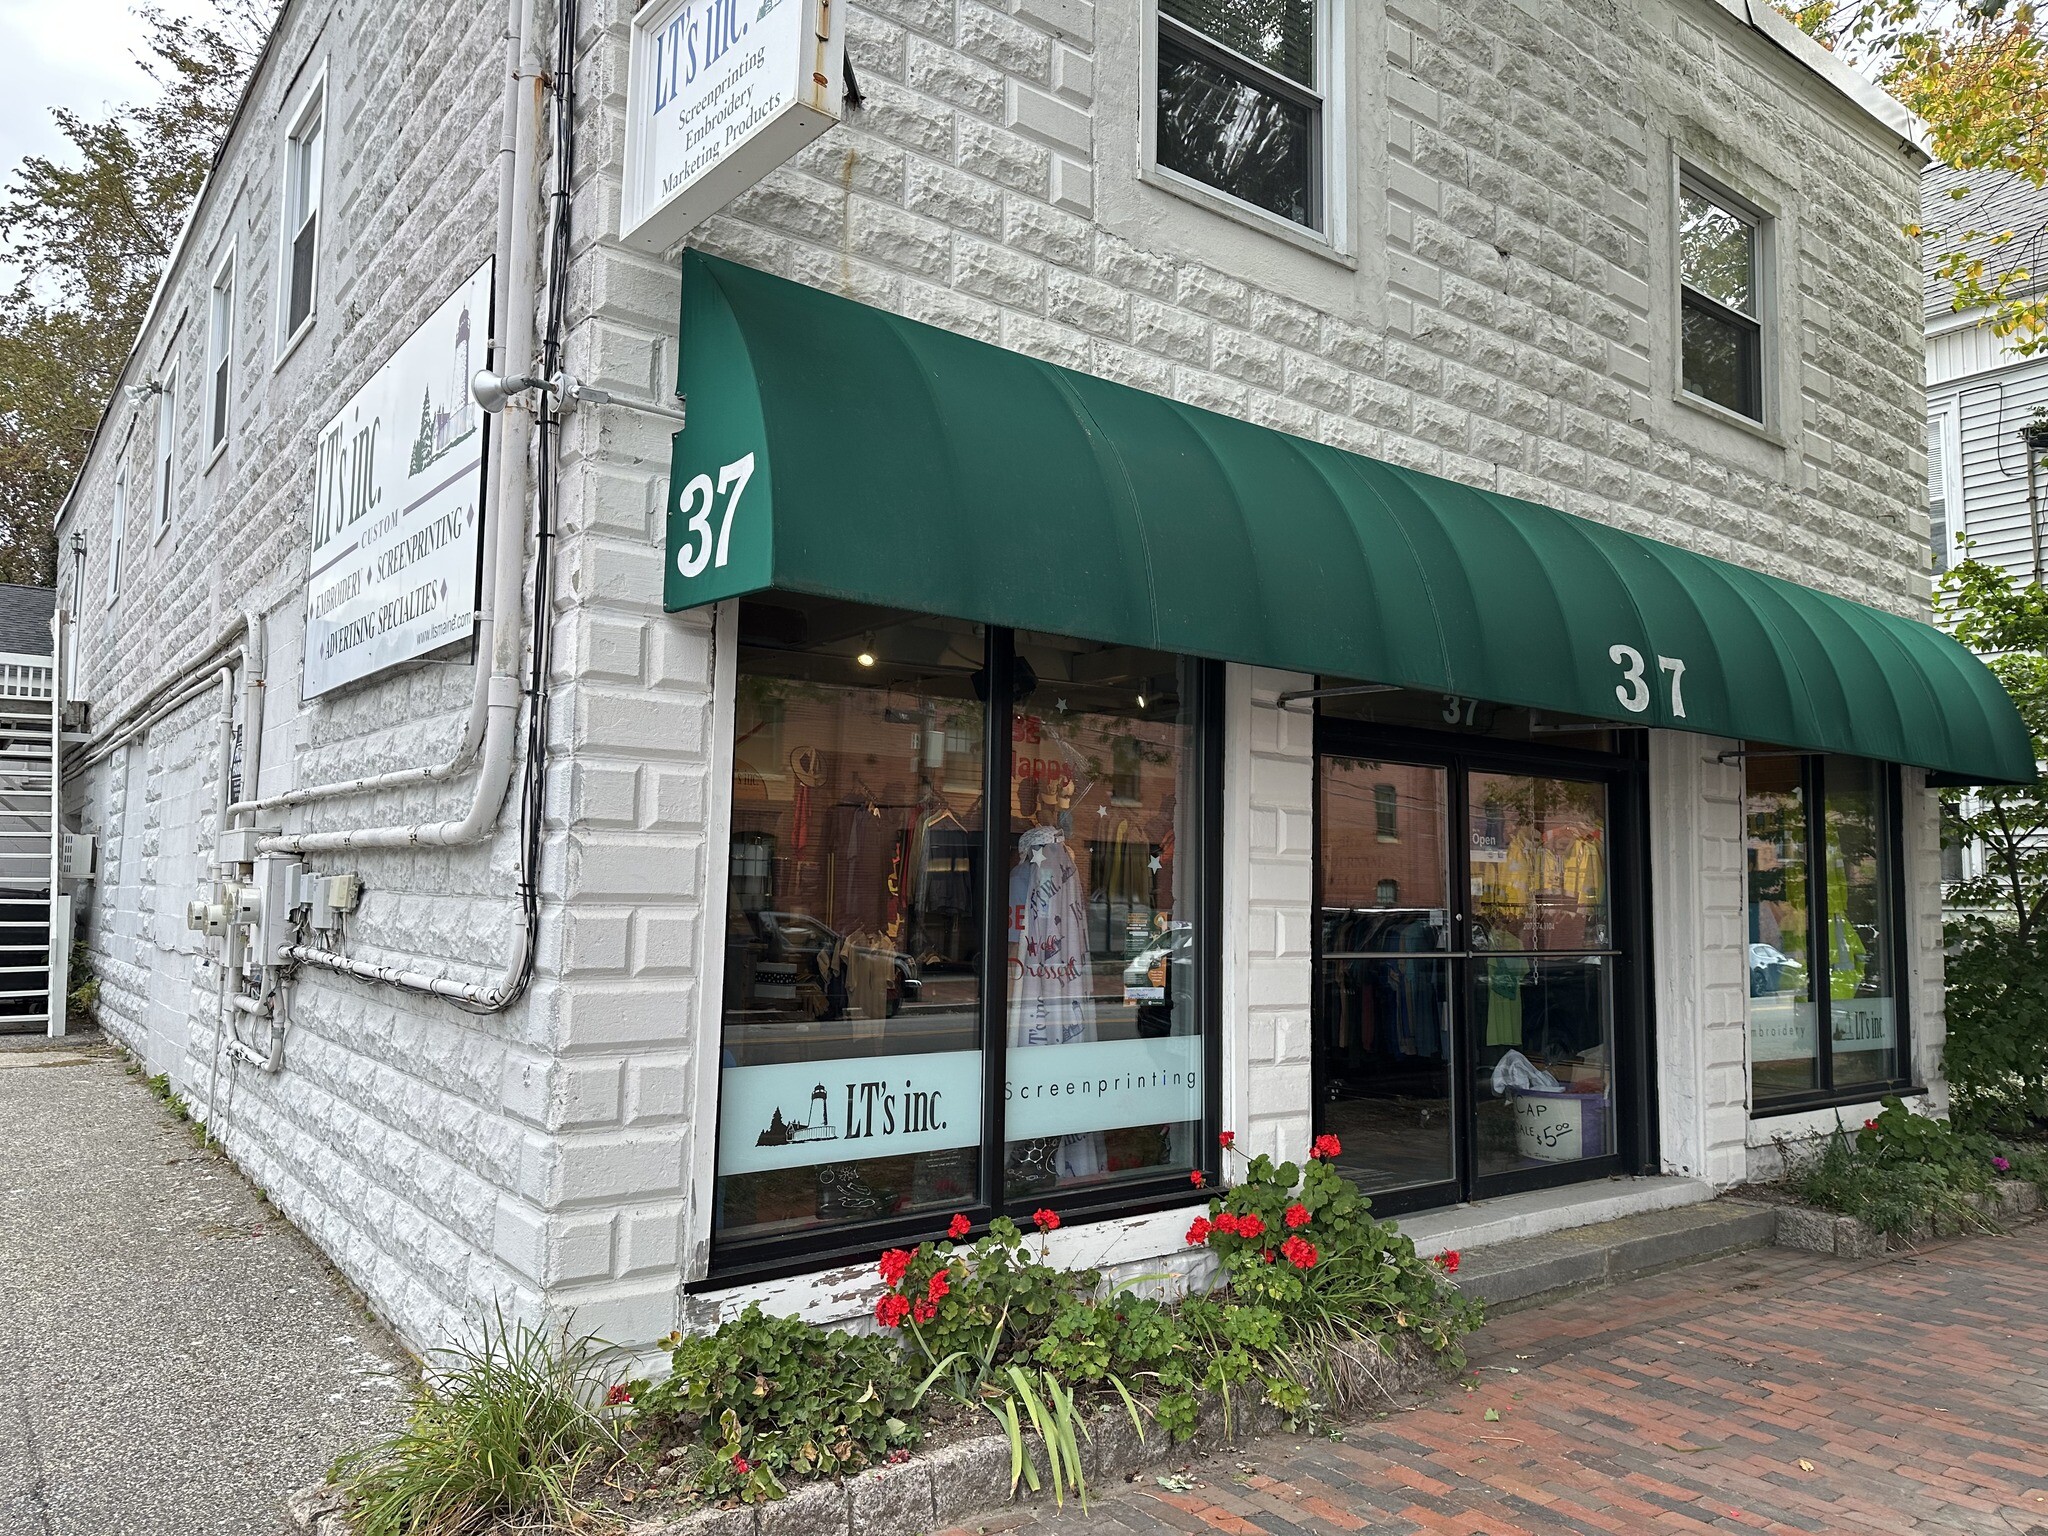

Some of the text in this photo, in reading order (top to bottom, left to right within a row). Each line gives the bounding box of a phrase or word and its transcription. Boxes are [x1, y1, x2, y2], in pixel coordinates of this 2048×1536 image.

[653, 6, 698, 116] LT's
[678, 46, 766, 130] Screenprinting
[662, 92, 781, 198] Marketing Products
[685, 83, 754, 152] Embroidery
[313, 406, 382, 553] LT's inc.
[361, 508, 399, 549] CUSTOM
[677, 452, 755, 578] 37
[315, 506, 463, 620] EMBROIDERY SCREENPRINTING
[324, 579, 438, 661] ADVERTISING SPECIALTIES
[1442, 695, 1479, 726] 37
[1609, 644, 1686, 718] 37
[1472, 832, 1496, 847] Open
[1751, 1023, 1806, 1038] mbroidery
[1855, 1011, 1885, 1040] LT's inc.
[844, 1079, 947, 1140] LT's inc.
[1004, 1070, 1196, 1100] Screenprinting
[1515, 1095, 1547, 1117] CAP
